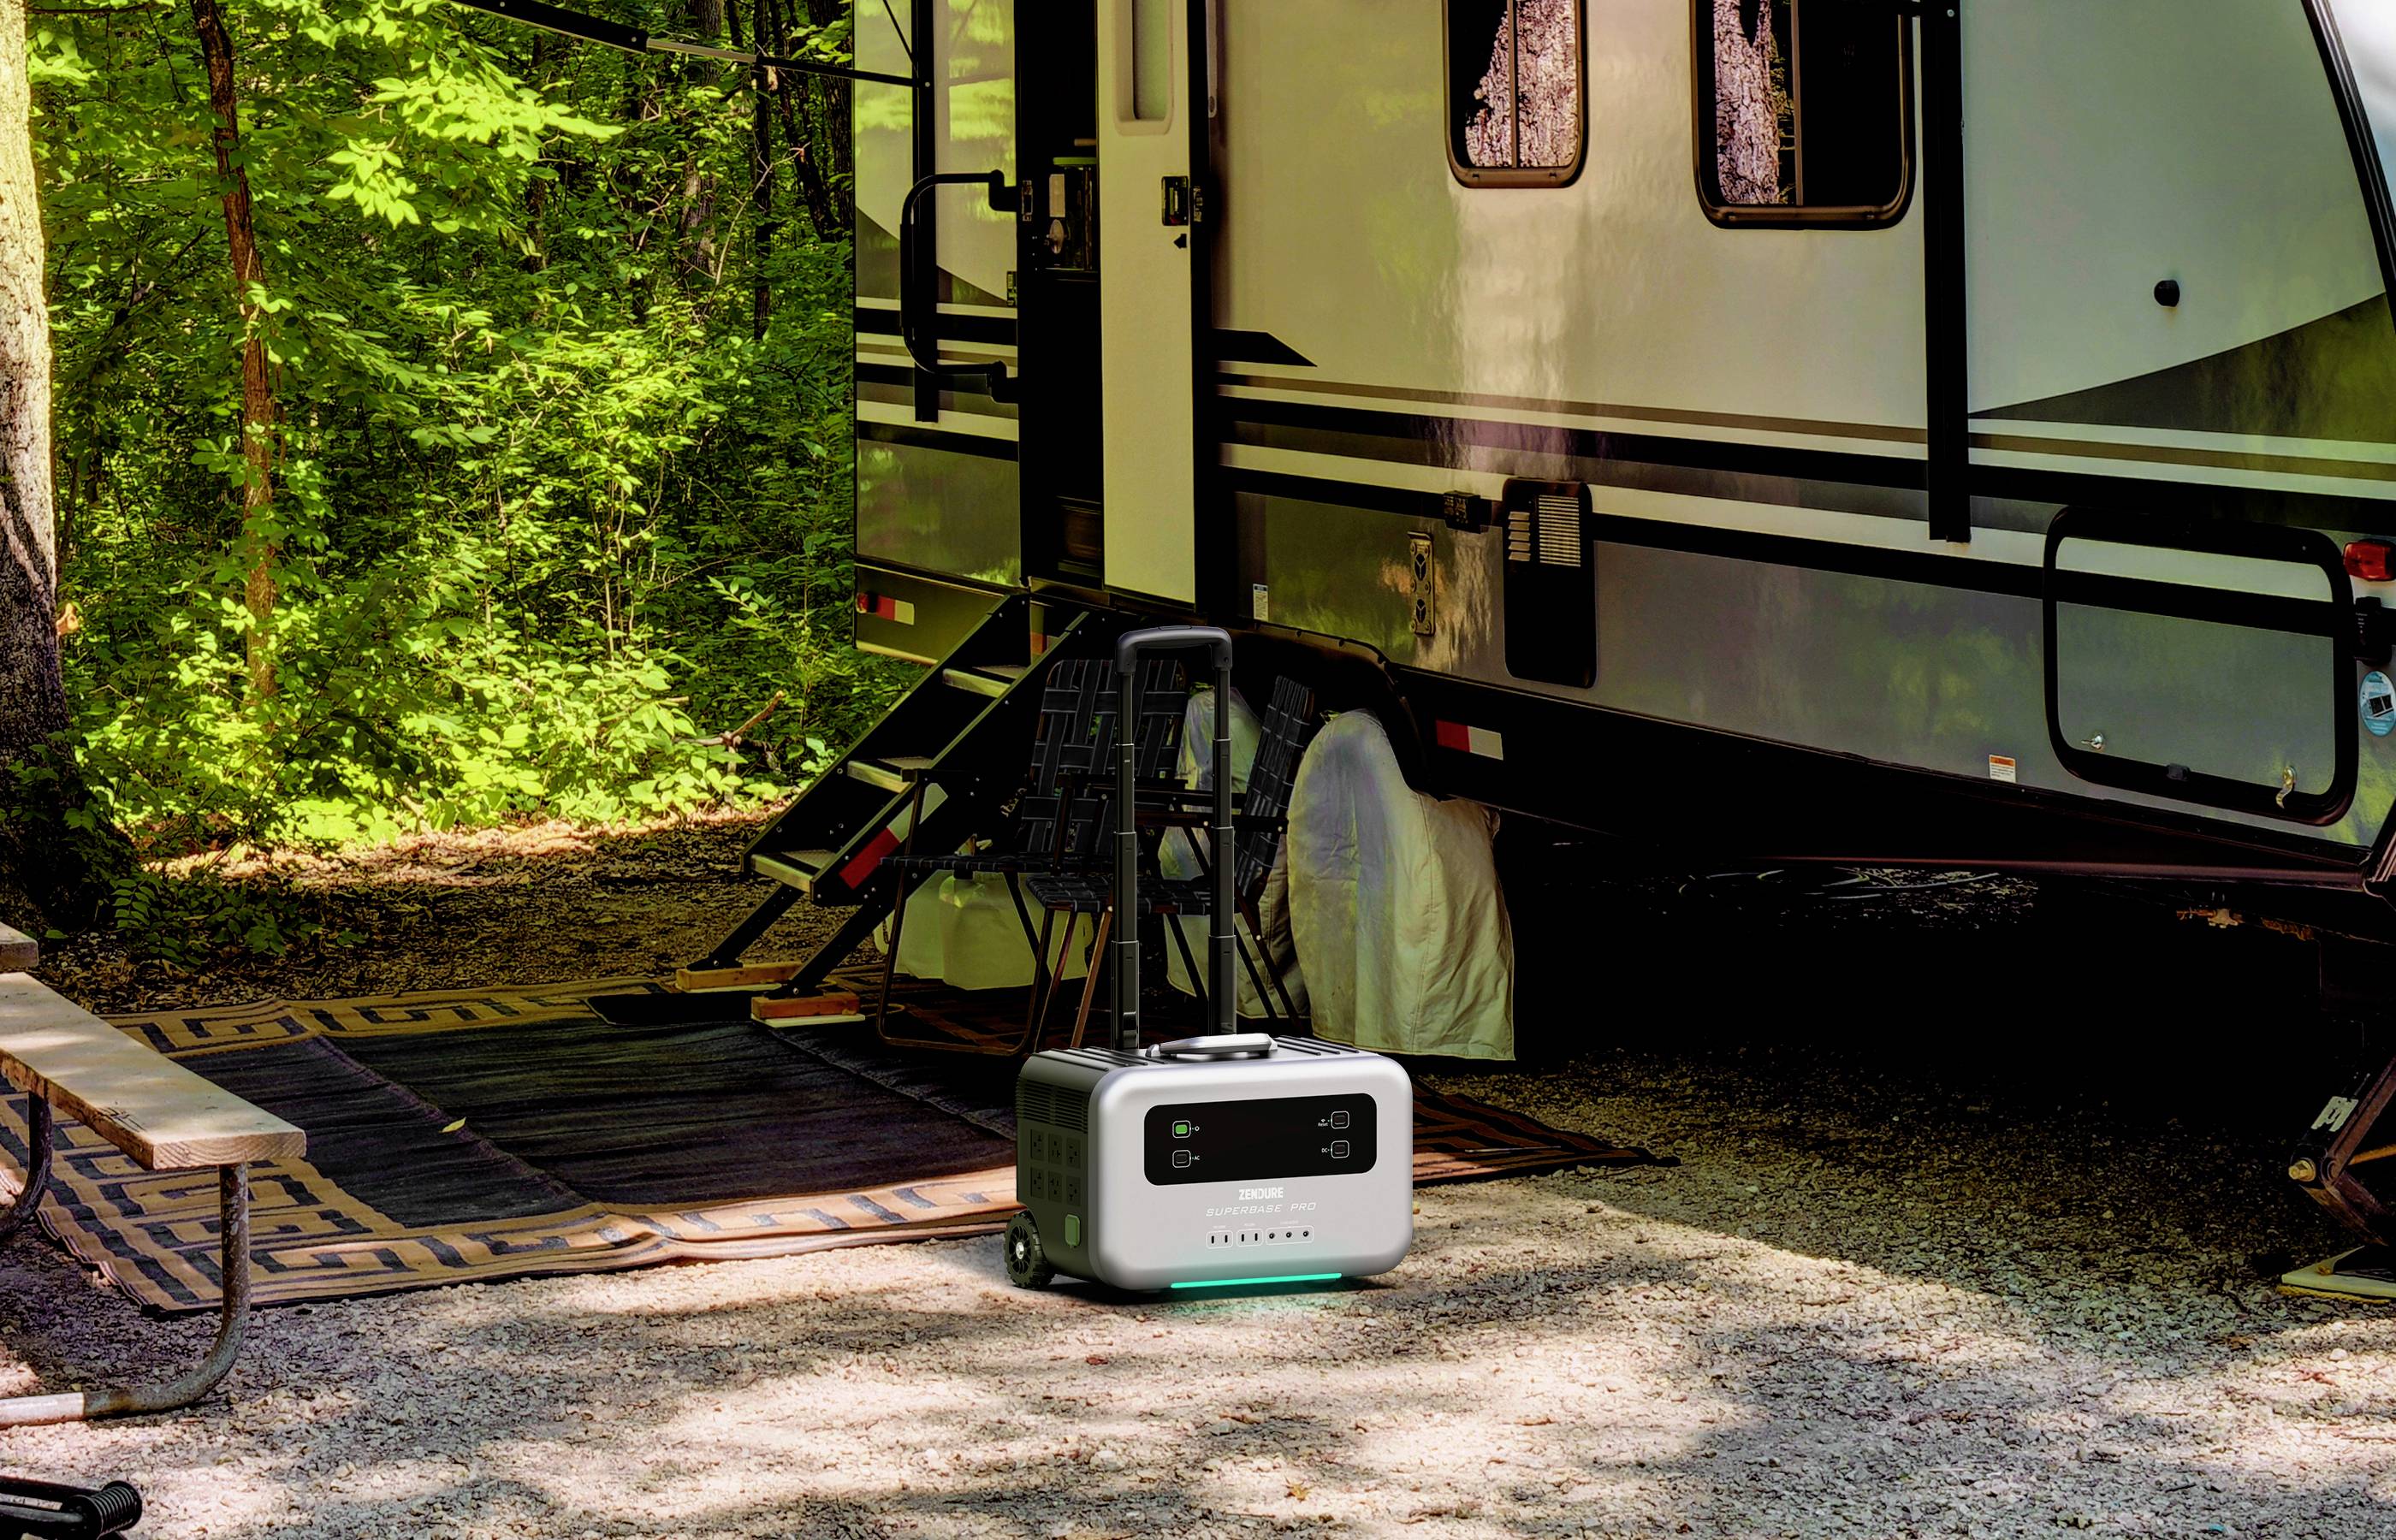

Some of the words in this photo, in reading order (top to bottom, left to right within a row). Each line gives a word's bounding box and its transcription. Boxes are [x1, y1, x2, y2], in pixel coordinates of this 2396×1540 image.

[1238, 1187, 1284, 1200] ZENDURE
[1206, 1204, 1283, 1217] SUPERBASE
[1290, 1202, 1317, 1211] PRO
